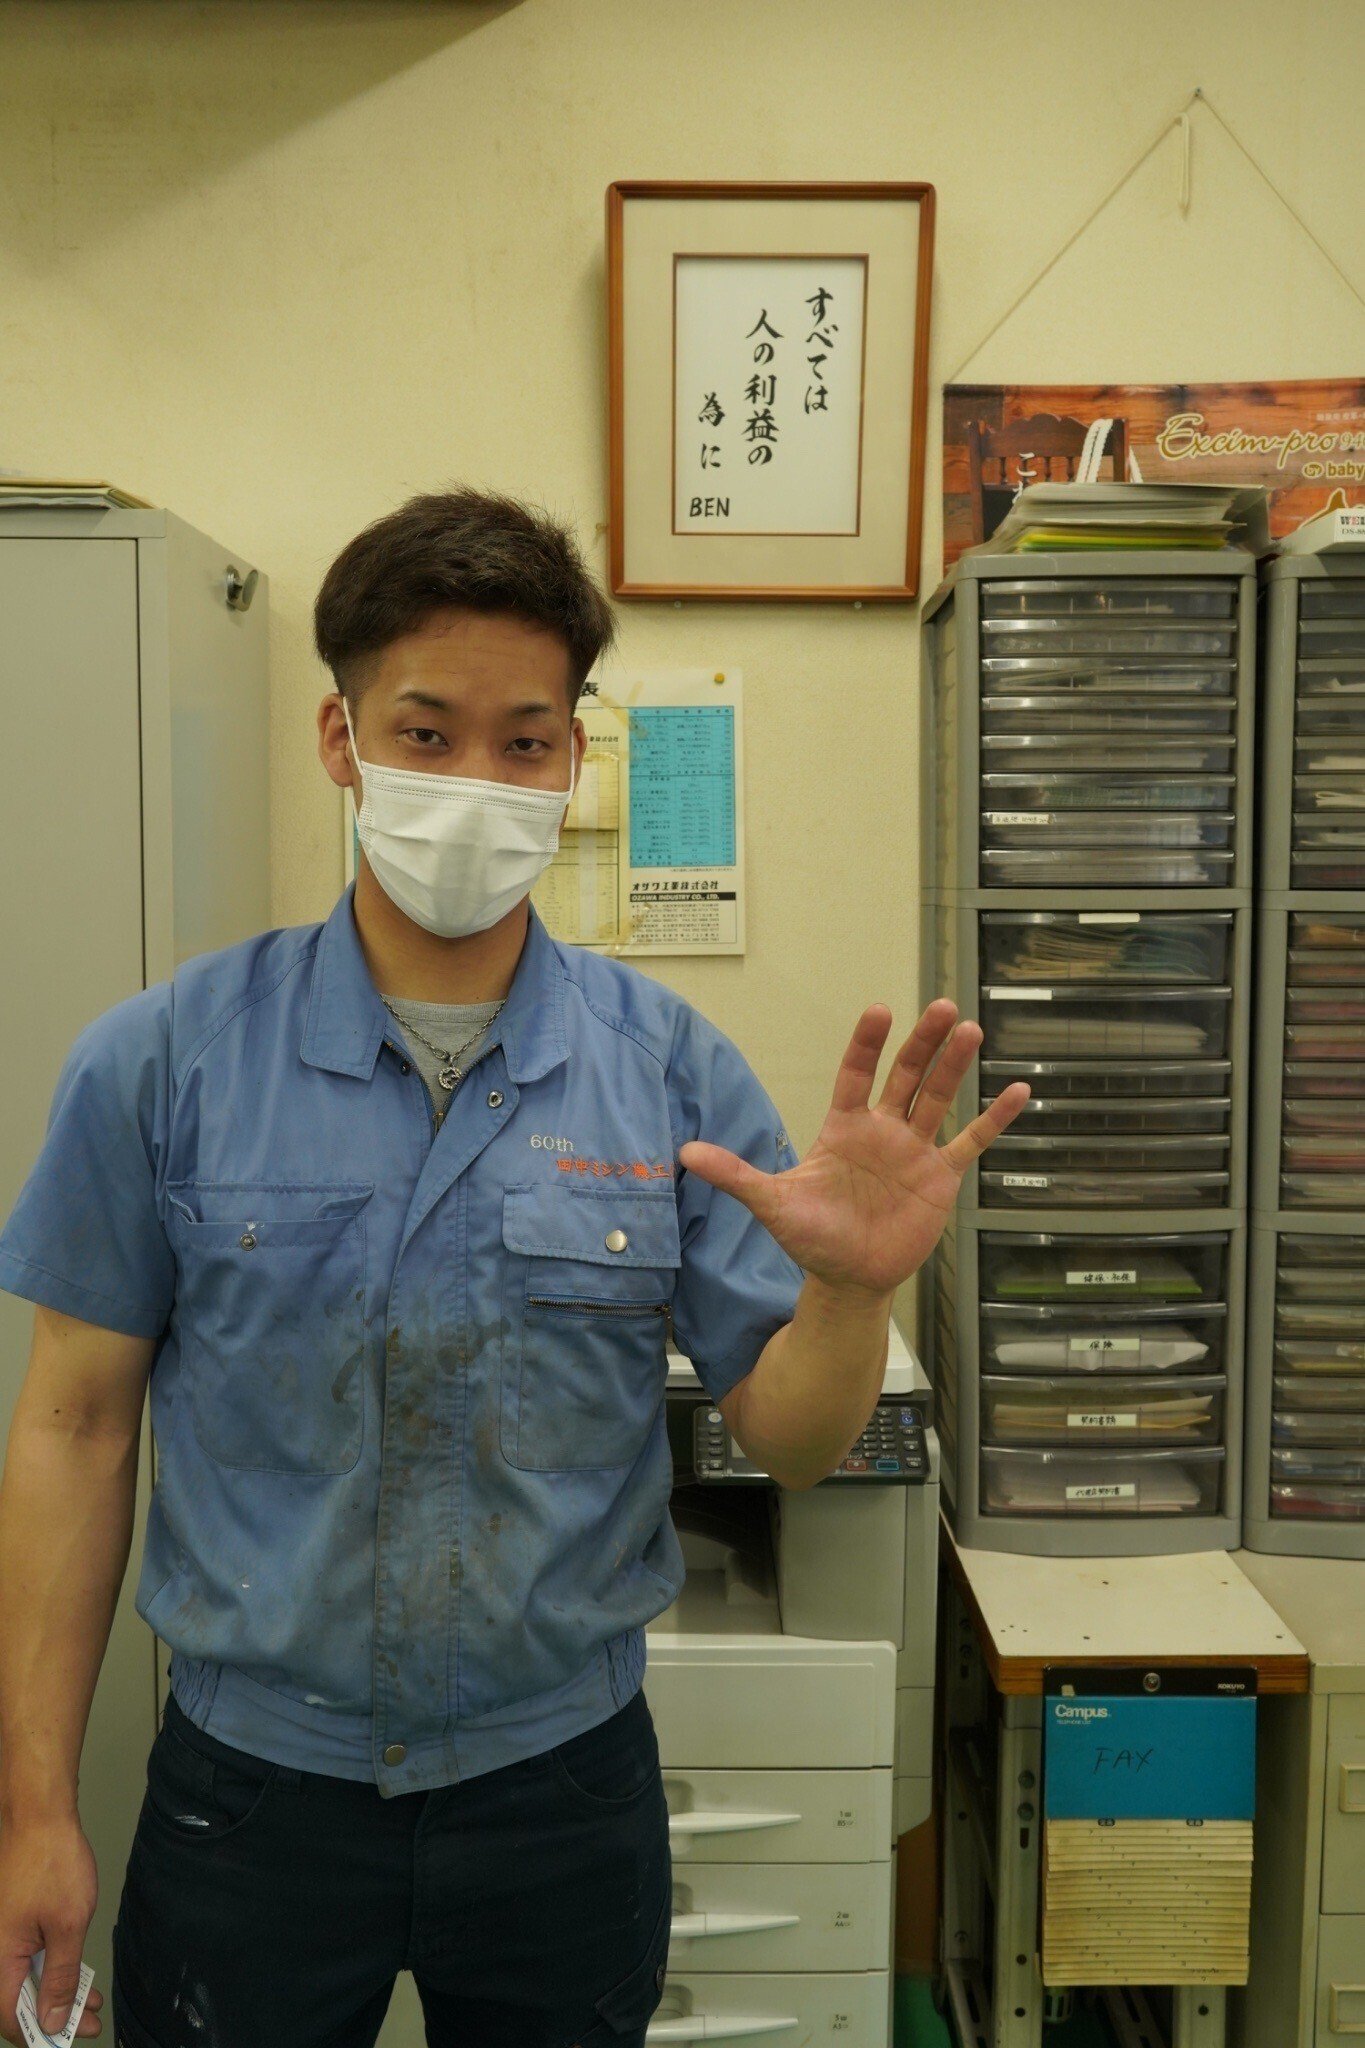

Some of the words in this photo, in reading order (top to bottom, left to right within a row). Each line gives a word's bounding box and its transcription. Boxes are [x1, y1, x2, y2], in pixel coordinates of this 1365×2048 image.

[805, 286, 839, 415] すべては
[741, 308, 785, 466] 人の利益の
[698, 391, 726, 470] 為に
[1156, 412, 1338, 470] Excim-pro
[689, 497, 730, 518] BEN
[631, 894, 658, 902] OZAWA
[658, 893, 690, 901] INDUSTRY
[530, 1134, 574, 1152] 60th
[1055, 1703, 1108, 1720] Campus
[1092, 1747, 1154, 1775] FAX
